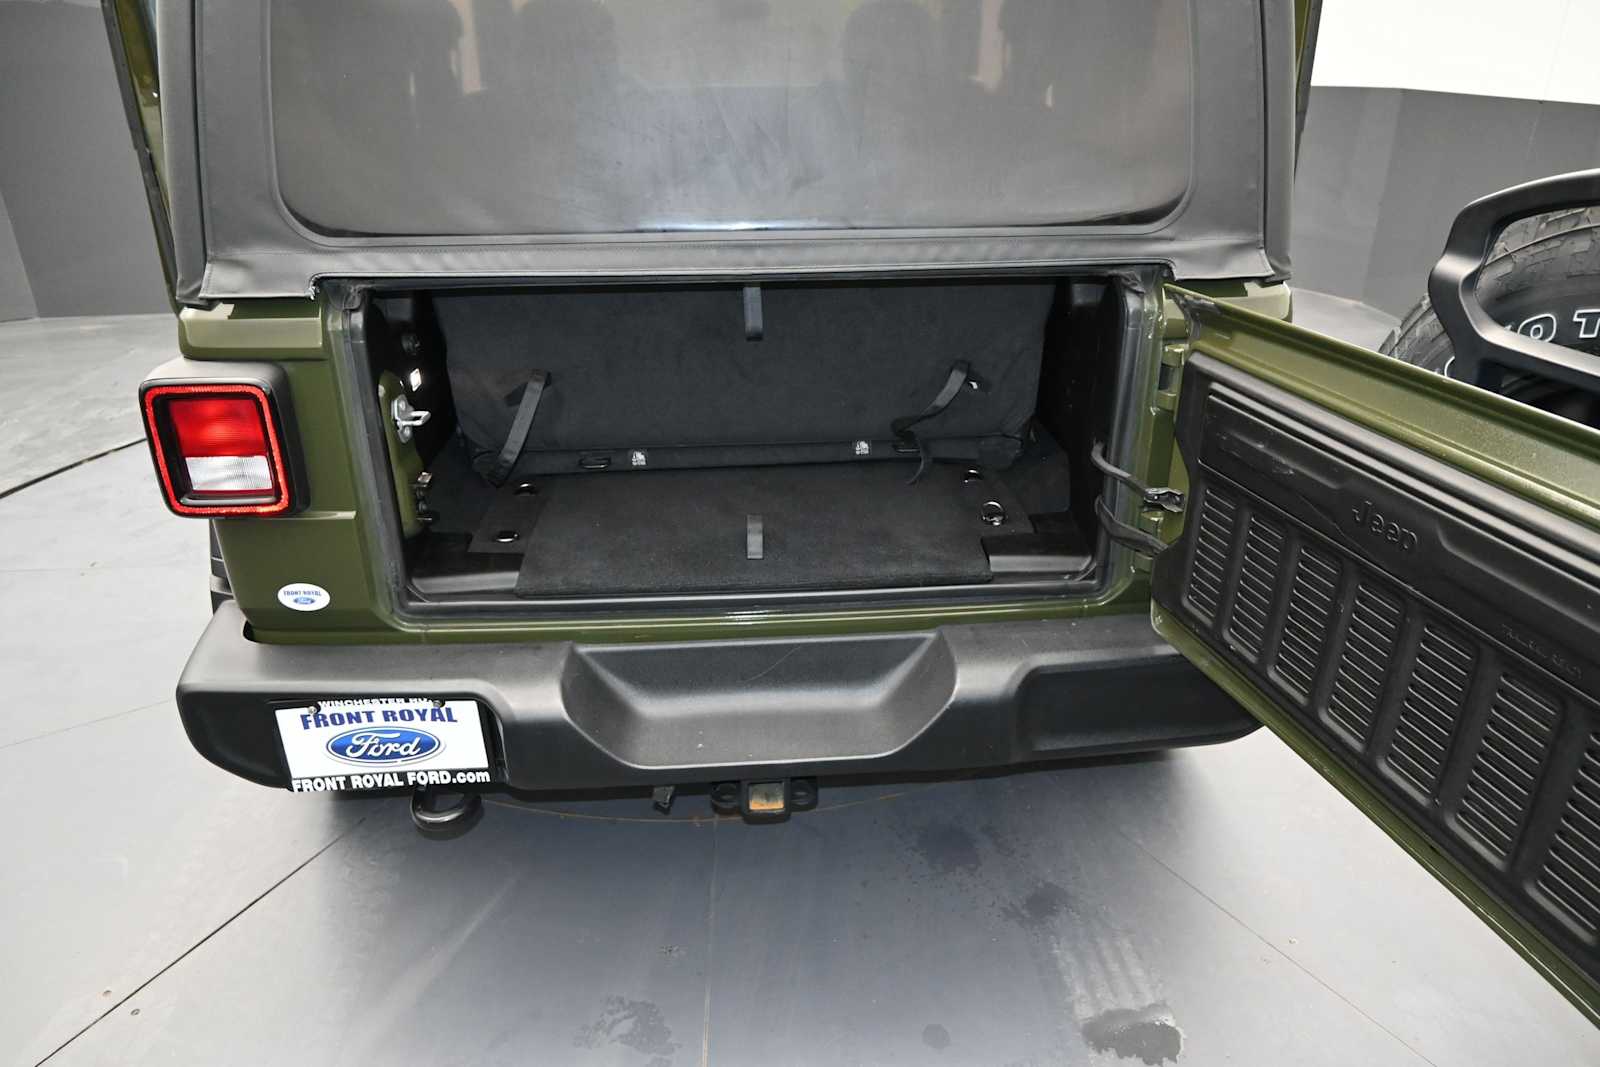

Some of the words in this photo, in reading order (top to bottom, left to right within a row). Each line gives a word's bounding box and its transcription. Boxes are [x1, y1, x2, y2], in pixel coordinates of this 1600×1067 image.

[1349, 499, 1419, 549] Jeep
[300, 711, 376, 730] FRONT
[382, 706, 458, 723] ROYAL
[345, 732, 422, 758] Ford
[291, 776, 346, 793] FRONT
[351, 773, 404, 790] ROYAL
[406, 770, 491, 787] FORD.com
